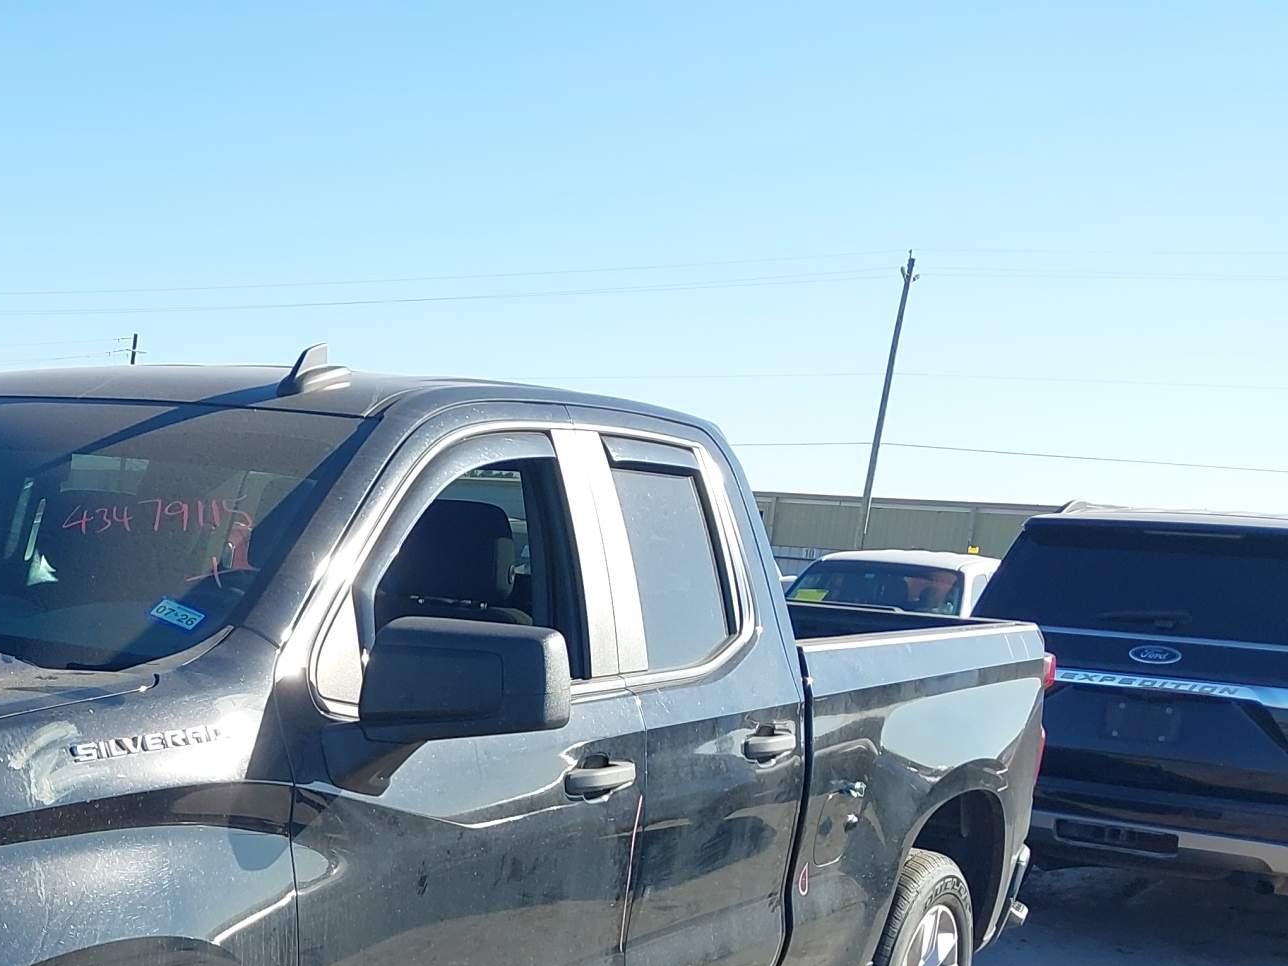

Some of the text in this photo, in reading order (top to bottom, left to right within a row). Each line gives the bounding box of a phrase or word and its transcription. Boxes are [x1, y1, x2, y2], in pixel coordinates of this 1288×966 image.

[1139, 649, 1169, 662] Ford
[1059, 671, 1240, 697] EXPEDITION
[69, 725, 234, 765] SILVERAD
